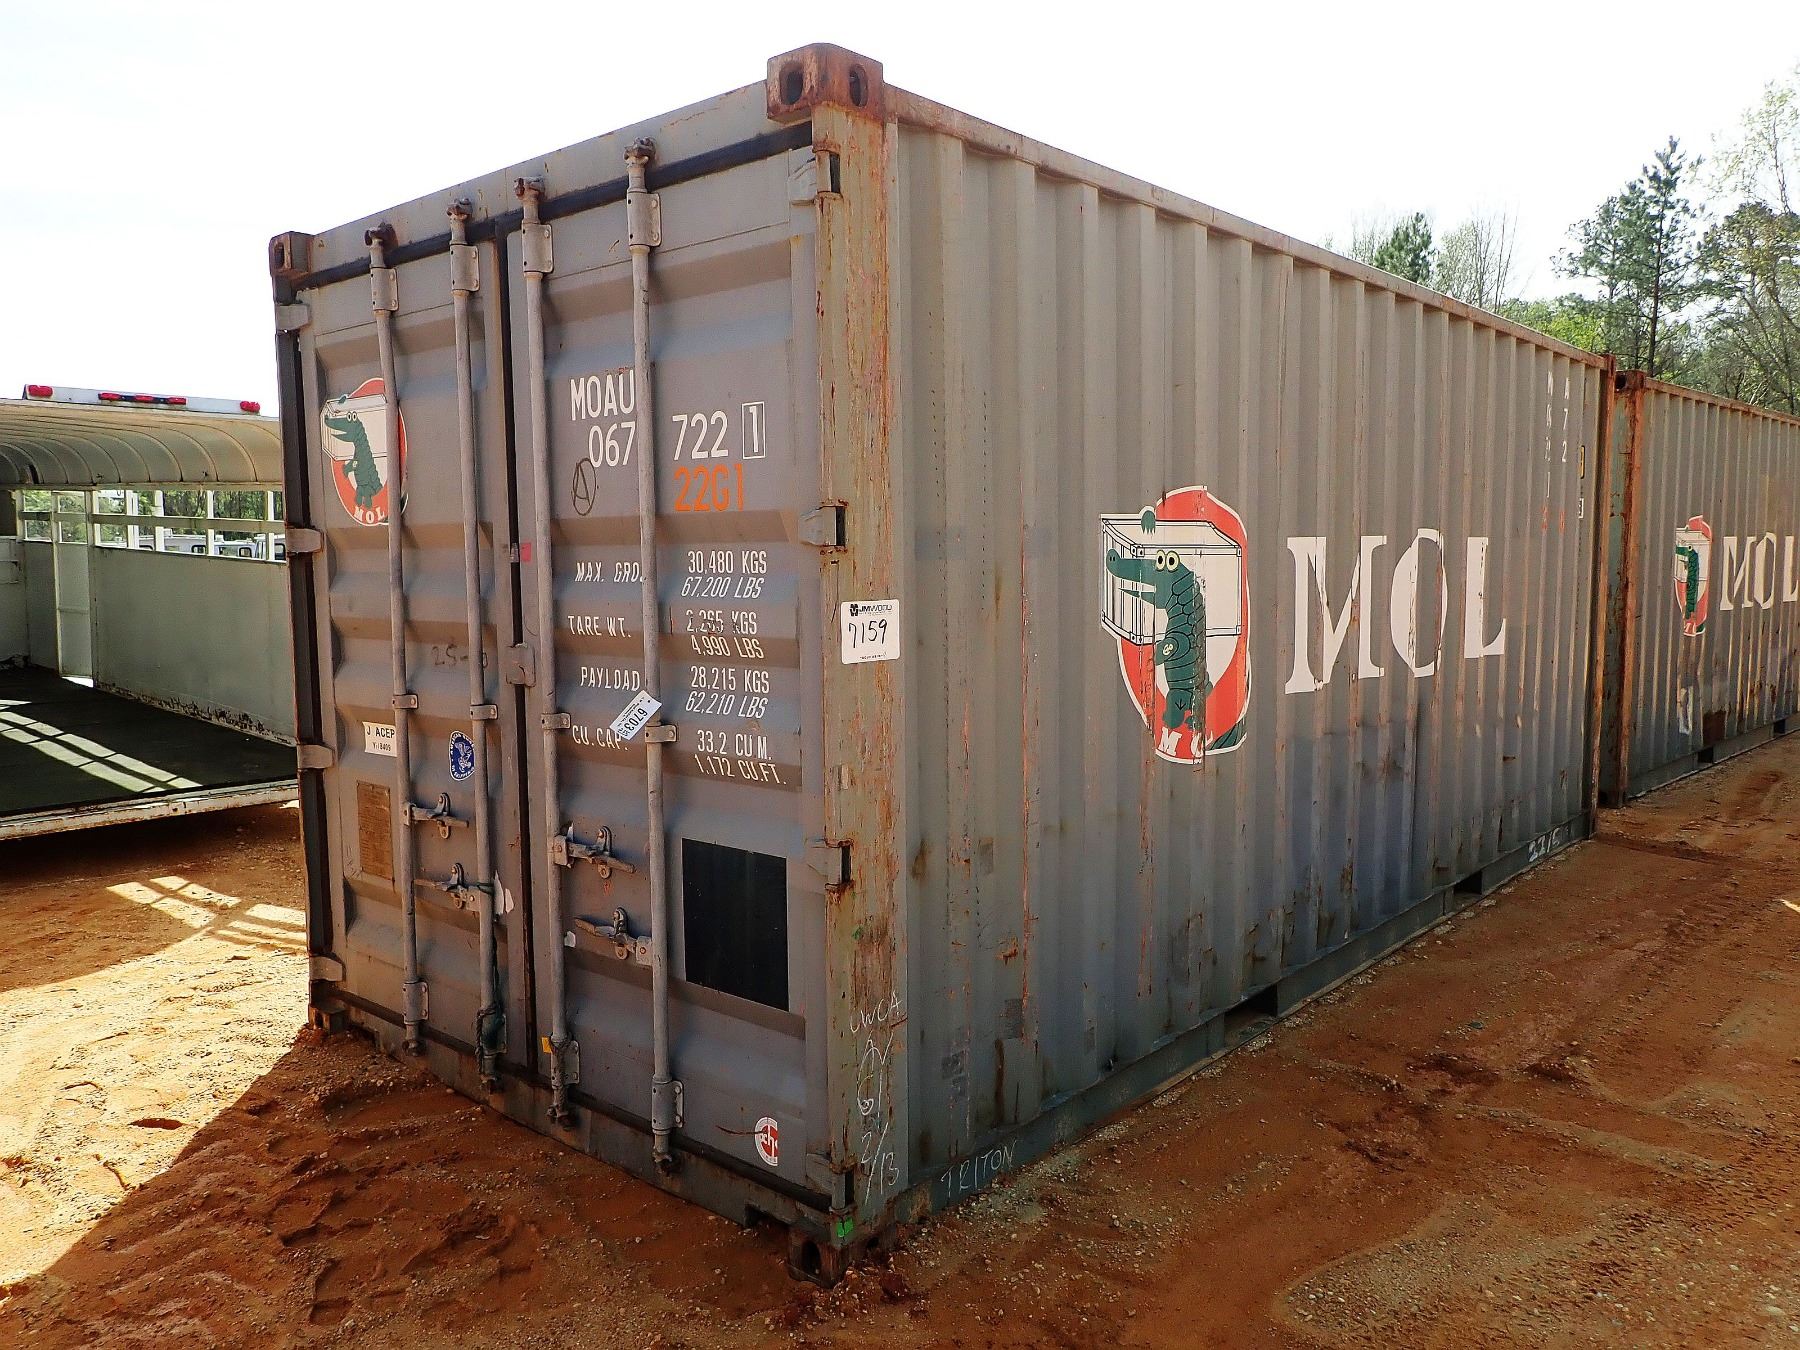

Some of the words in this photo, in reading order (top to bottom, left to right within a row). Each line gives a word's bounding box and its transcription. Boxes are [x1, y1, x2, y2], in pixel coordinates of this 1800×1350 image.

[570, 369, 635, 421] MOAU
[588, 421, 636, 468] 067
[672, 410, 729, 460] 722
[673, 463, 744, 512] 22G1
[353, 506, 385, 524] MOL
[575, 562, 605, 582] MAX.
[688, 550, 734, 574] 30,480
[741, 550, 767, 574] KGS
[1720, 532, 1799, 612] MOL
[681, 577, 731, 599] 67,200
[734, 577, 765, 599] LBS
[731, 610, 757, 635] KGS
[1284, 528, 1507, 694] MOL
[567, 615, 602, 636] TARE
[606, 616, 632, 638] WT.
[848, 618, 888, 649] 7159
[691, 634, 731, 657] 4,990
[733, 636, 765, 659] LBS
[580, 666, 641, 691] PAYLOAD
[690, 665, 736, 691] 28,215
[743, 669, 770, 694] KGS
[685, 691, 735, 715] 62,210
[738, 694, 769, 719] LBS
[623, 708, 648, 732] 6703
[697, 729, 727, 755] 33.2
[940, 1136, 1018, 1198] TRITON
